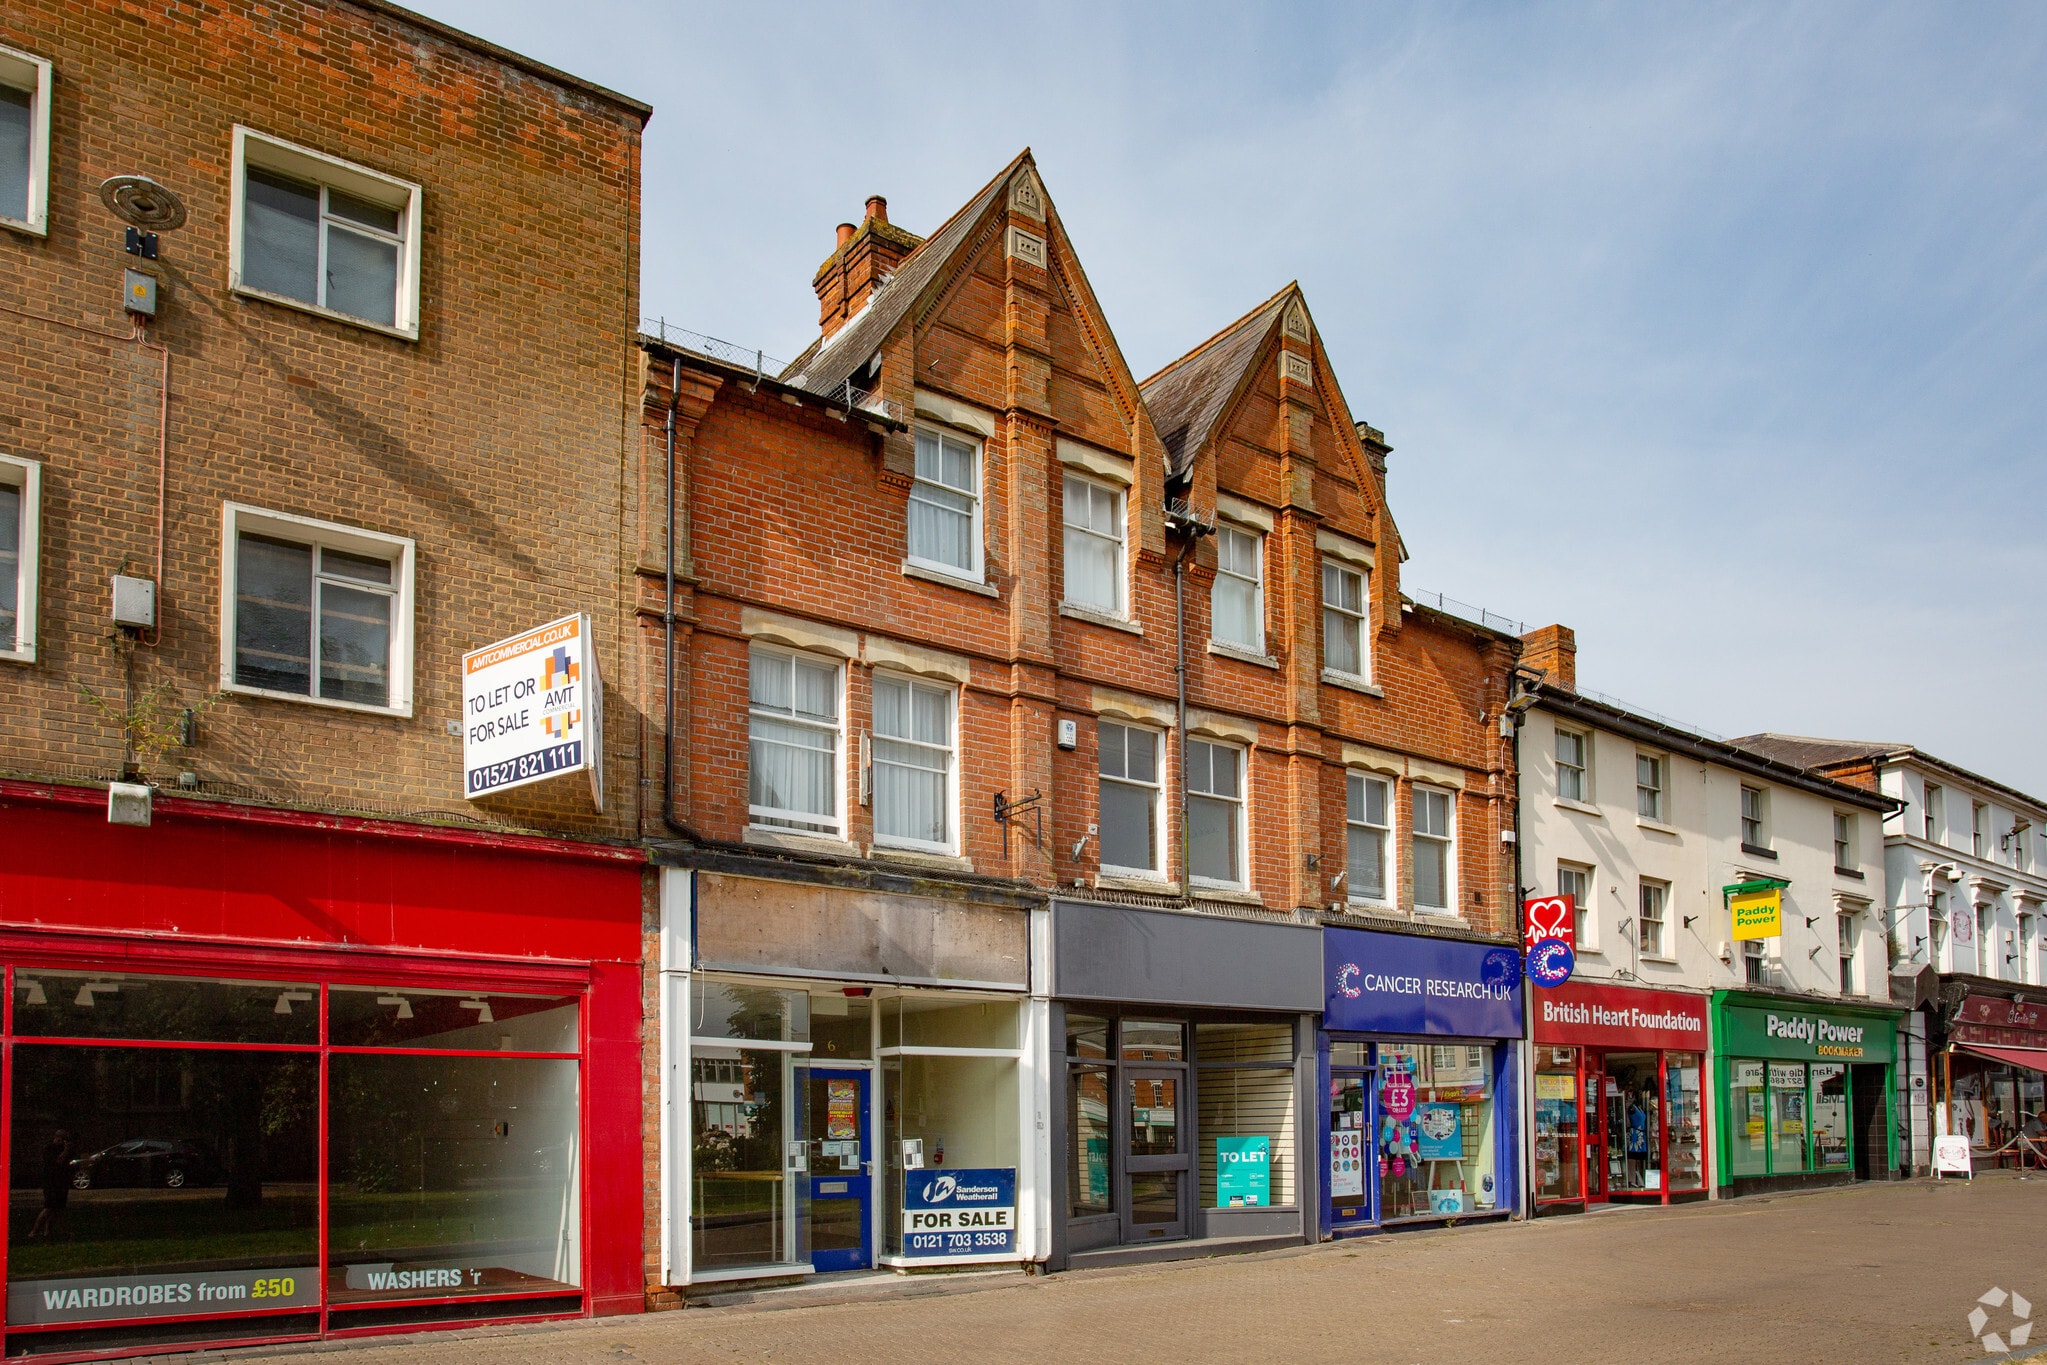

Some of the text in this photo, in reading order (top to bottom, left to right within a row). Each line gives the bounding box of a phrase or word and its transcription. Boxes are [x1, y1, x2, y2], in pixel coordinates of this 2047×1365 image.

[471, 624, 572, 670] AMTCOMMERCIAL.CO.UK
[469, 678, 536, 715] TO LET OR
[544, 686, 574, 708] AMT
[542, 702, 576, 716] COMMERCIAL
[470, 709, 529, 745] FOR SALE
[473, 743, 575, 790] 01527 821 111
[1737, 905, 1775, 917] Paddy
[1737, 915, 1776, 927] Power
[1364, 973, 1422, 995] CANCER
[1426, 979, 1491, 1000] RESEARCH
[1494, 985, 1512, 1001] UK
[1543, 1001, 1701, 1032] British Heart Foundation
[1766, 1014, 1863, 1044] Paddy Power
[827, 1040, 836, 1051] 6
[1817, 1045, 1863, 1057] BOOKMAKER
[1391, 1088, 1409, 1107] £3
[1220, 1151, 1266, 1163] TO LET
[956, 1185, 998, 1193] Sanderson
[956, 1193, 998, 1201] Weatherall
[913, 1211, 1007, 1228] FOR SALE
[913, 1232, 1007, 1249] 0121 703 3538
[368, 1269, 462, 1290] WASHERS
[43, 1277, 295, 1310] WARDROBES from £50
